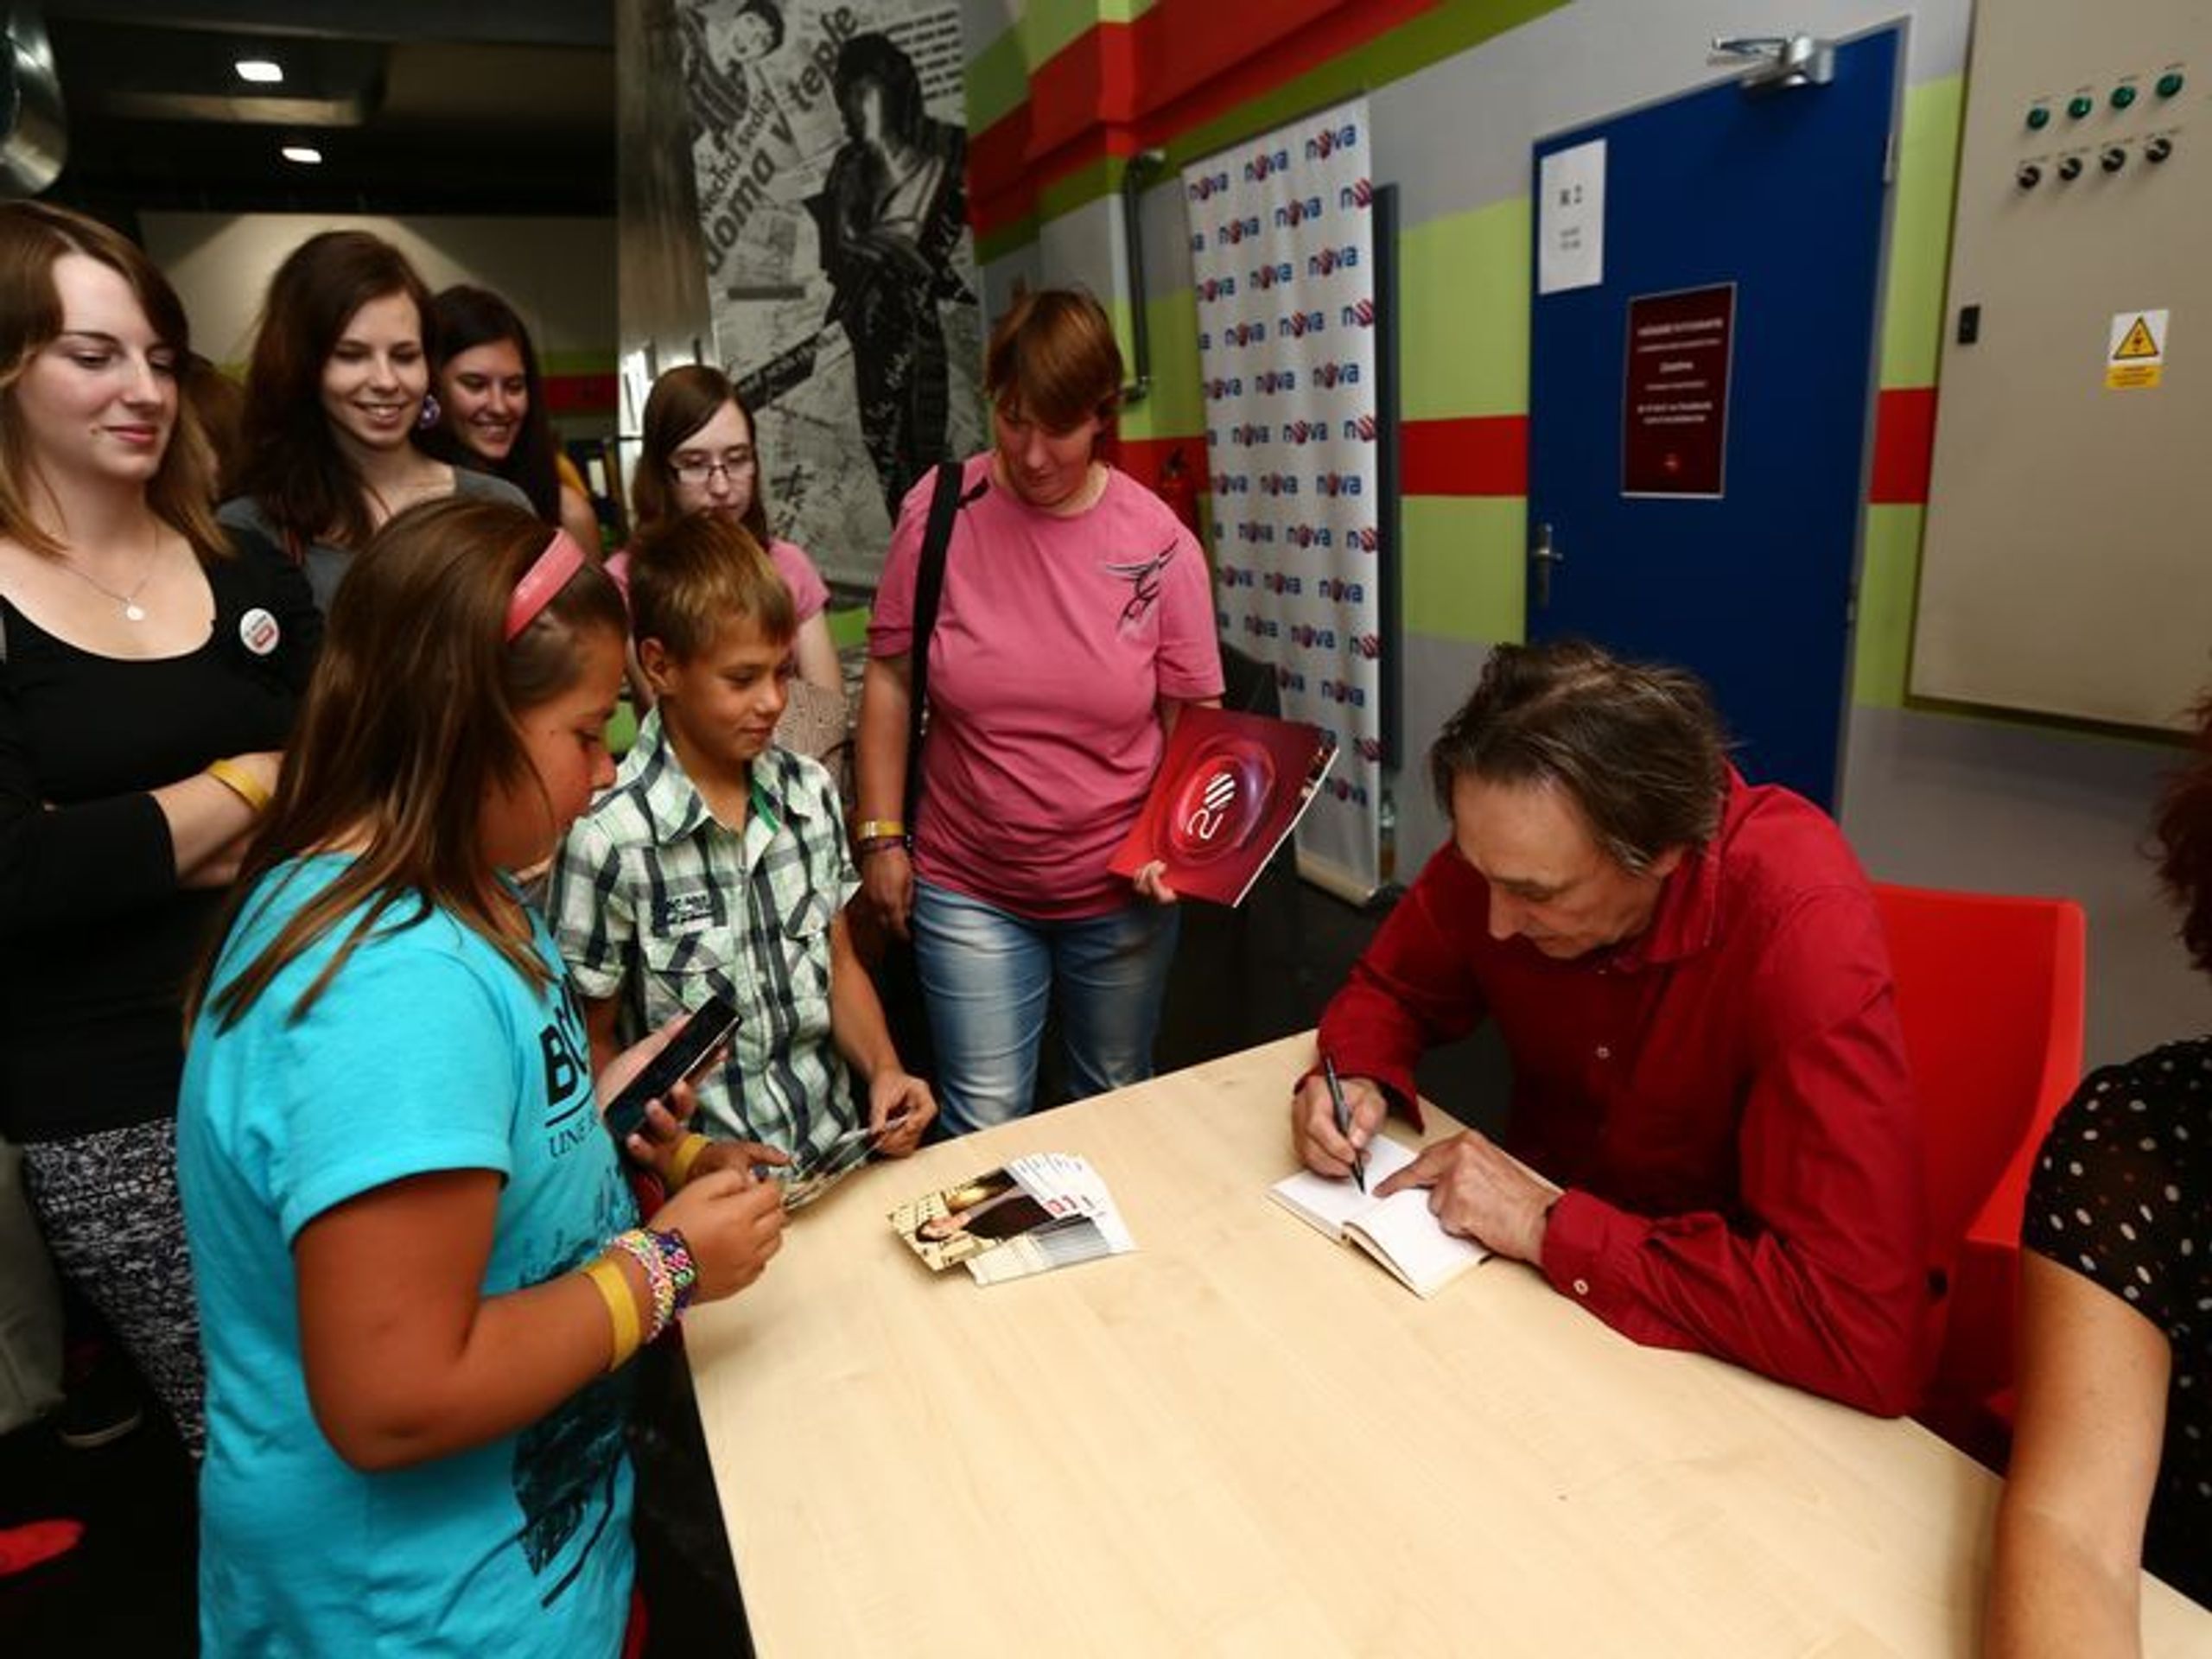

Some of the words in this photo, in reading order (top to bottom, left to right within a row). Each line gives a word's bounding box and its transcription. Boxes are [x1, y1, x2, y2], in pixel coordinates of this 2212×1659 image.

[1189, 172, 1228, 200] nova
[1244, 149, 1287, 181] nova
[1306, 125, 1356, 160] nova
[1219, 218, 1259, 245] nova
[1275, 196, 1321, 227] nova
[1250, 263, 1292, 289] nova
[1308, 246, 1358, 276] nova
[1225, 322, 1264, 347] nova
[1281, 312, 1324, 338] nova
[1255, 372, 1294, 395] nova
[1313, 363, 1359, 390] nova
[1233, 423, 1269, 447] nova
[1283, 420, 1328, 445] nova
[1317, 472, 1362, 498] nova
[1287, 524, 1332, 548] nova
[1319, 579, 1364, 603] nova
[1291, 624, 1335, 649] nova
[1322, 679, 1364, 709] nova
